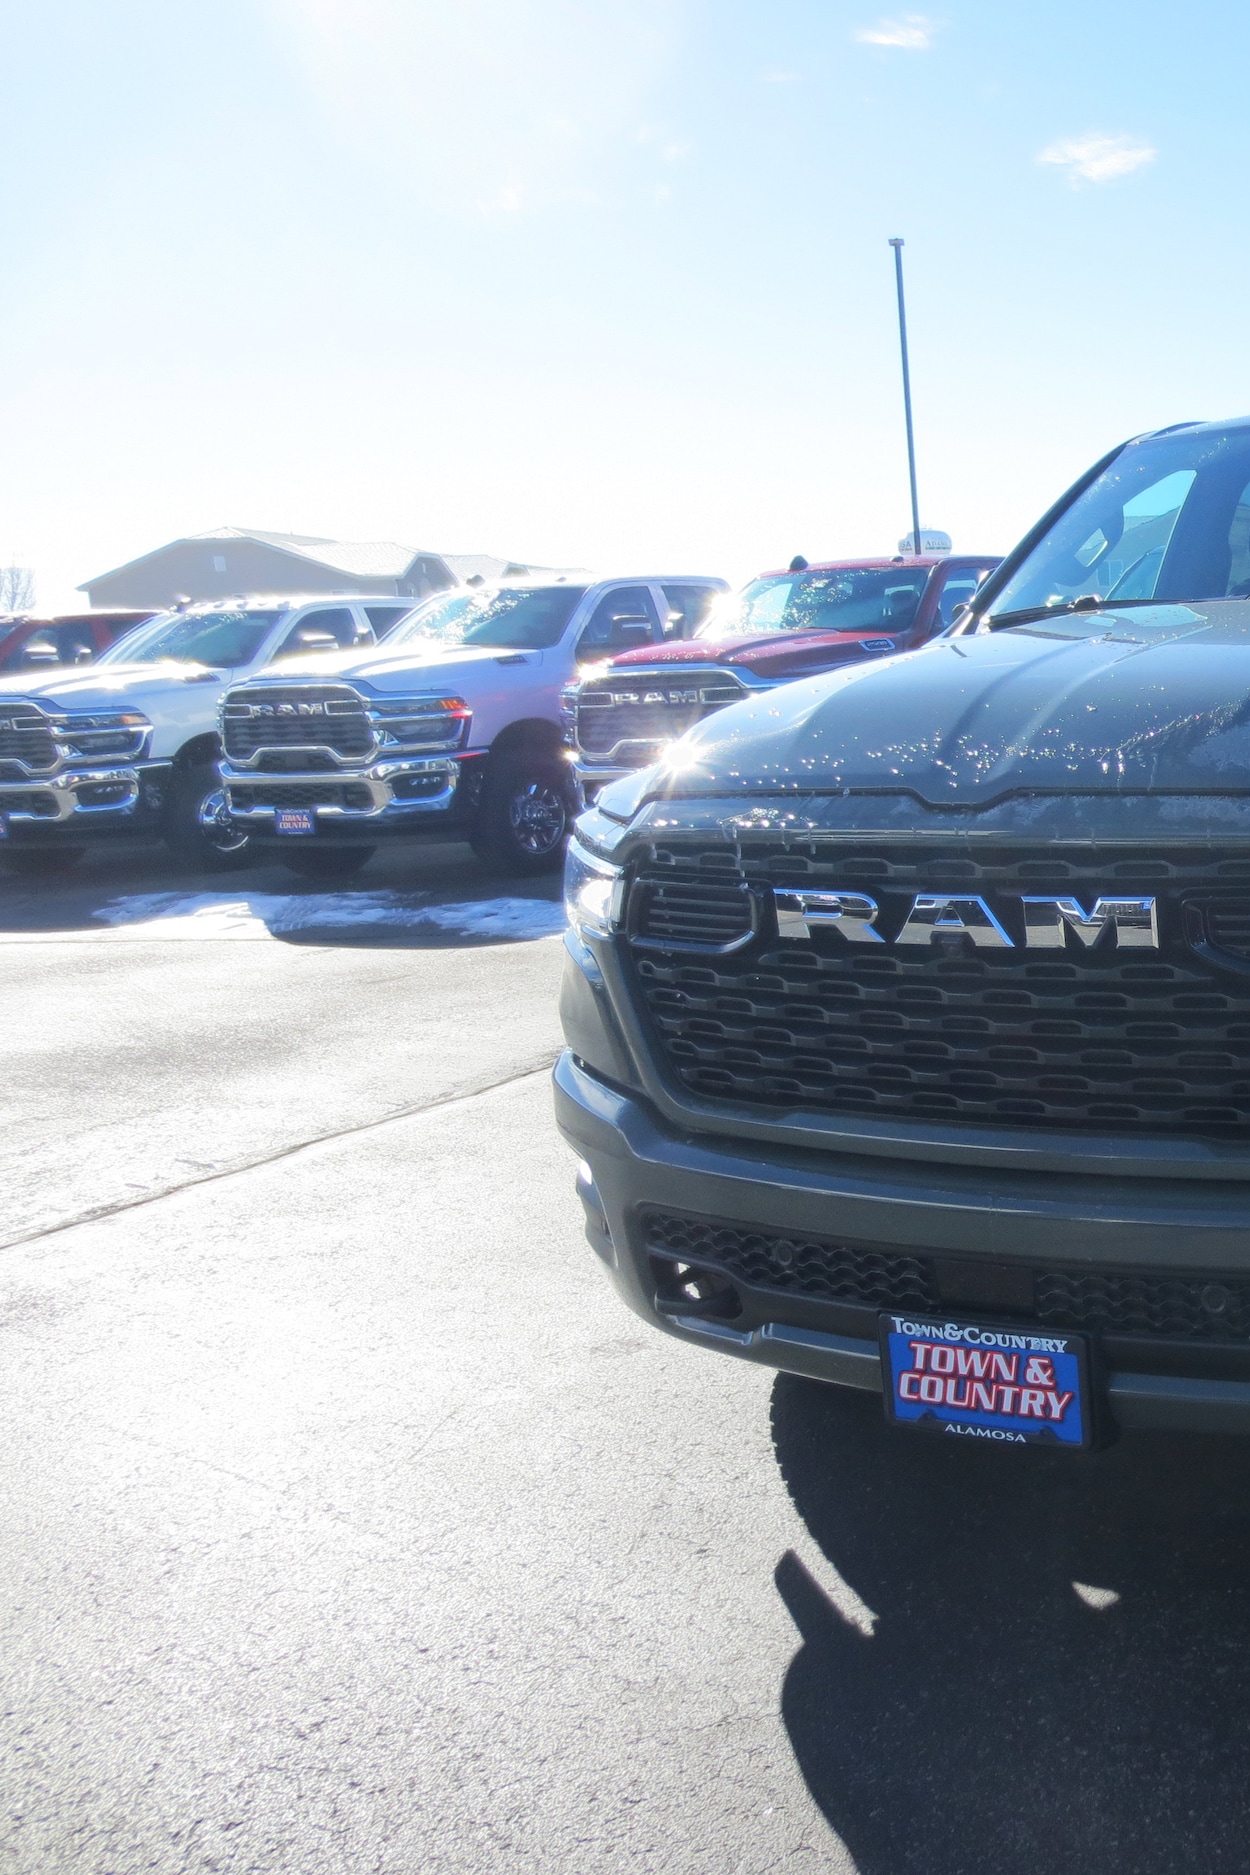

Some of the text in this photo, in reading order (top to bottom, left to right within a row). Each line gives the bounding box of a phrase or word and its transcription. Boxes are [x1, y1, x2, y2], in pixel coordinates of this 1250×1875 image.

[251, 703, 323, 717] RAM
[613, 690, 698, 705] RAM
[773, 888, 1160, 949] RAM
[909, 1341, 1056, 1388] TOWN &
[899, 1371, 1073, 1421] COUNTRY
[944, 1423, 1027, 1444] ALAMOSA
